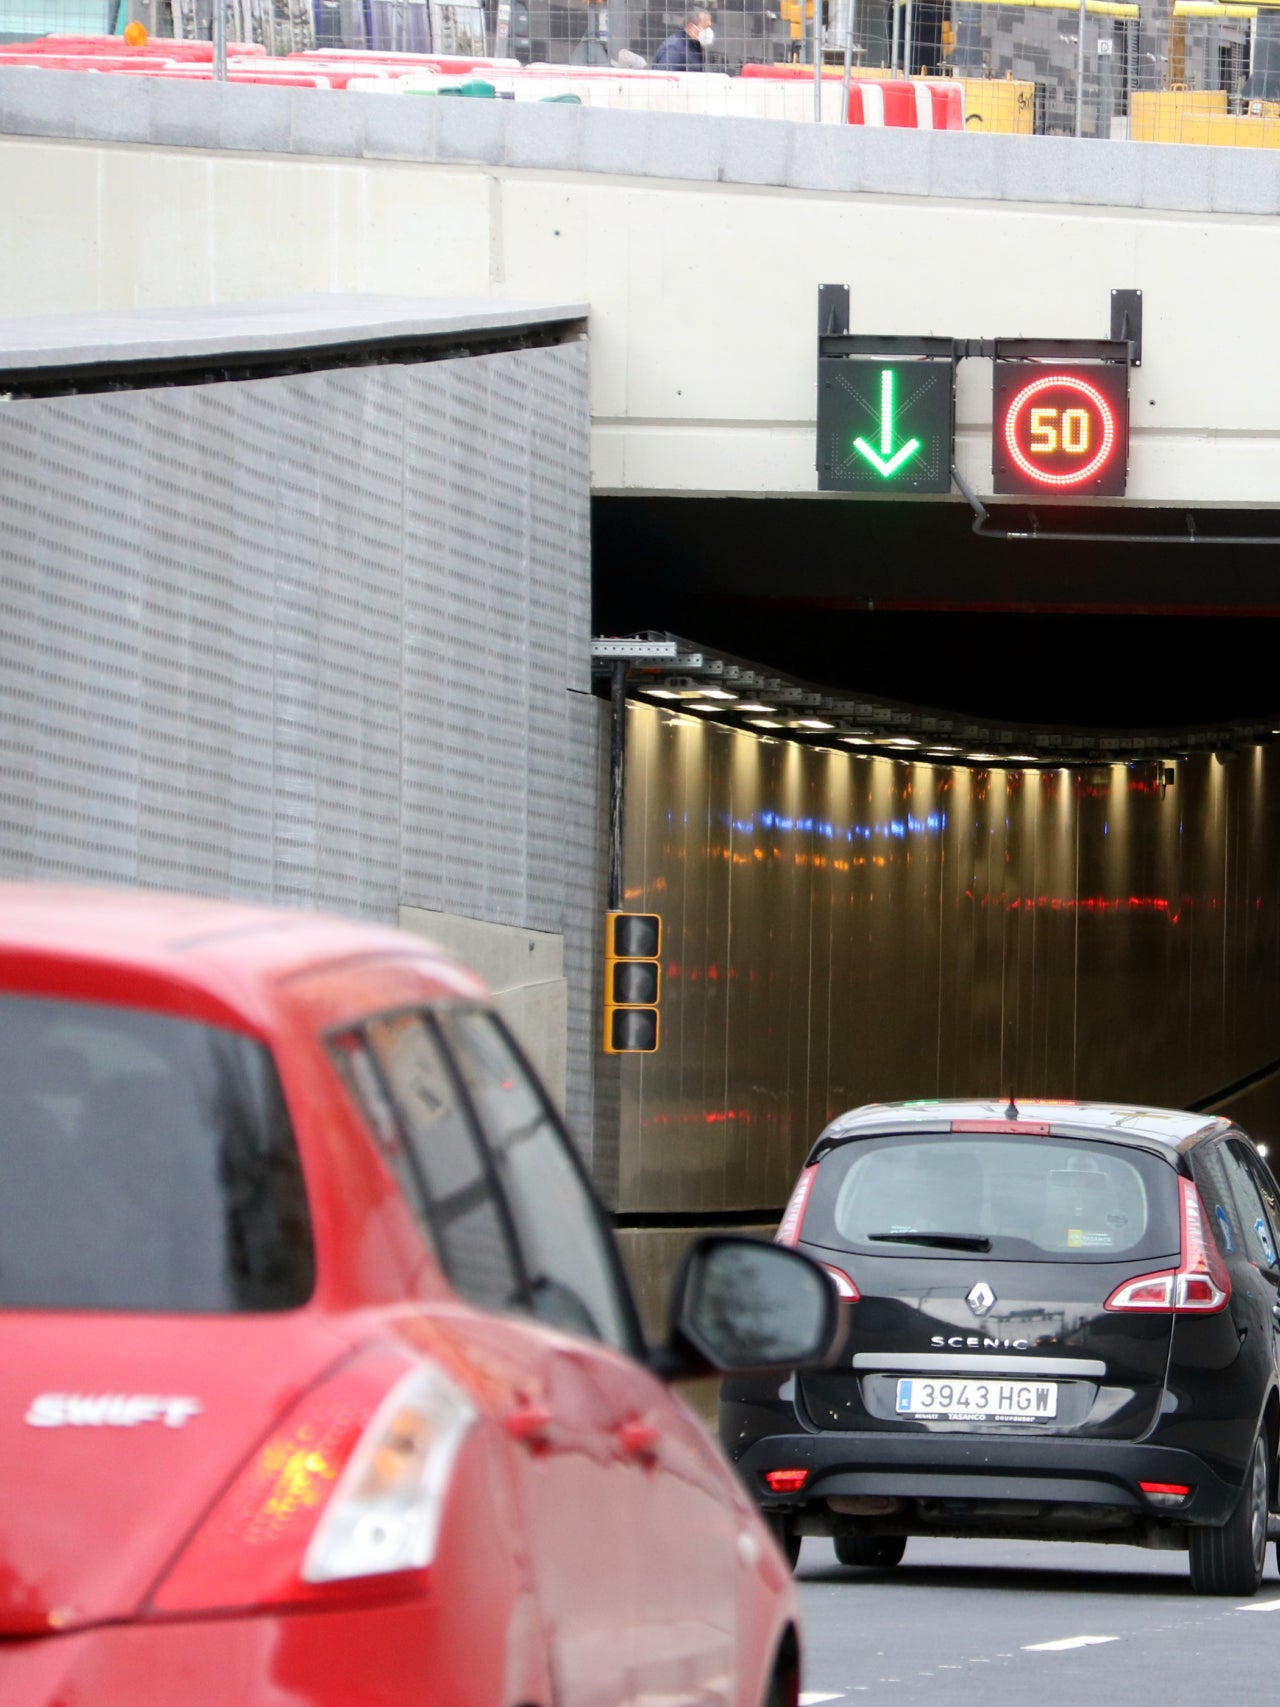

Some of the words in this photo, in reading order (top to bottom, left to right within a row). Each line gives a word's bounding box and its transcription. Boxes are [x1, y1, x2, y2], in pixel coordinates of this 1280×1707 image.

[1030, 408, 1088, 452] 50
[930, 1335, 1030, 1350] SCENIC
[24, 1392, 204, 1428] SWIFT
[920, 1384, 990, 1409] 3943
[998, 1386, 1050, 1412] HGW
[947, 1413, 987, 1421] TASANCO
